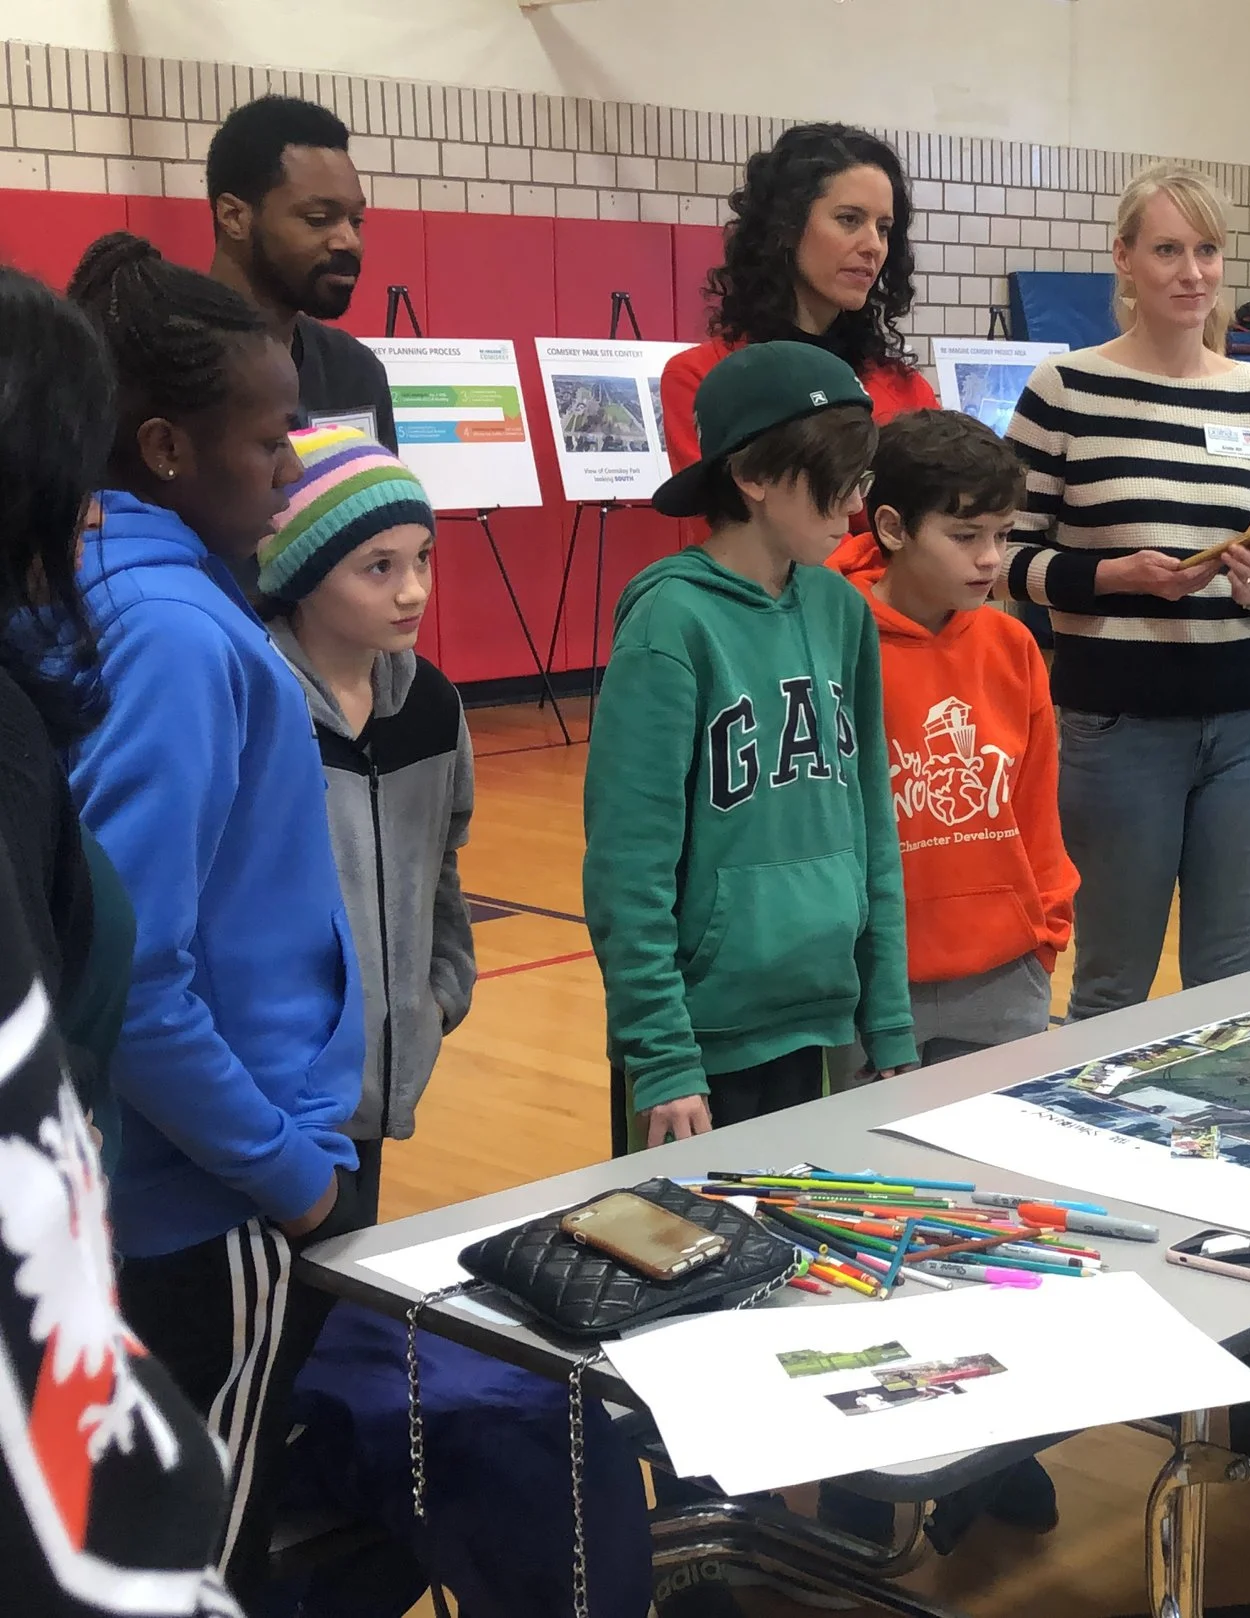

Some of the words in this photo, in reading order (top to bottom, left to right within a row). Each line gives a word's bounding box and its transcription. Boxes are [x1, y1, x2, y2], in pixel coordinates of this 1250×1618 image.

[388, 347, 428, 356] PLANNING
[429, 348, 461, 356] PROCESS
[547, 347, 582, 357] COMISKEY
[582, 348, 599, 357] PARK
[600, 349, 614, 357] SITE
[614, 349, 643, 358] CONTEXT
[707, 675, 859, 812] GAP
